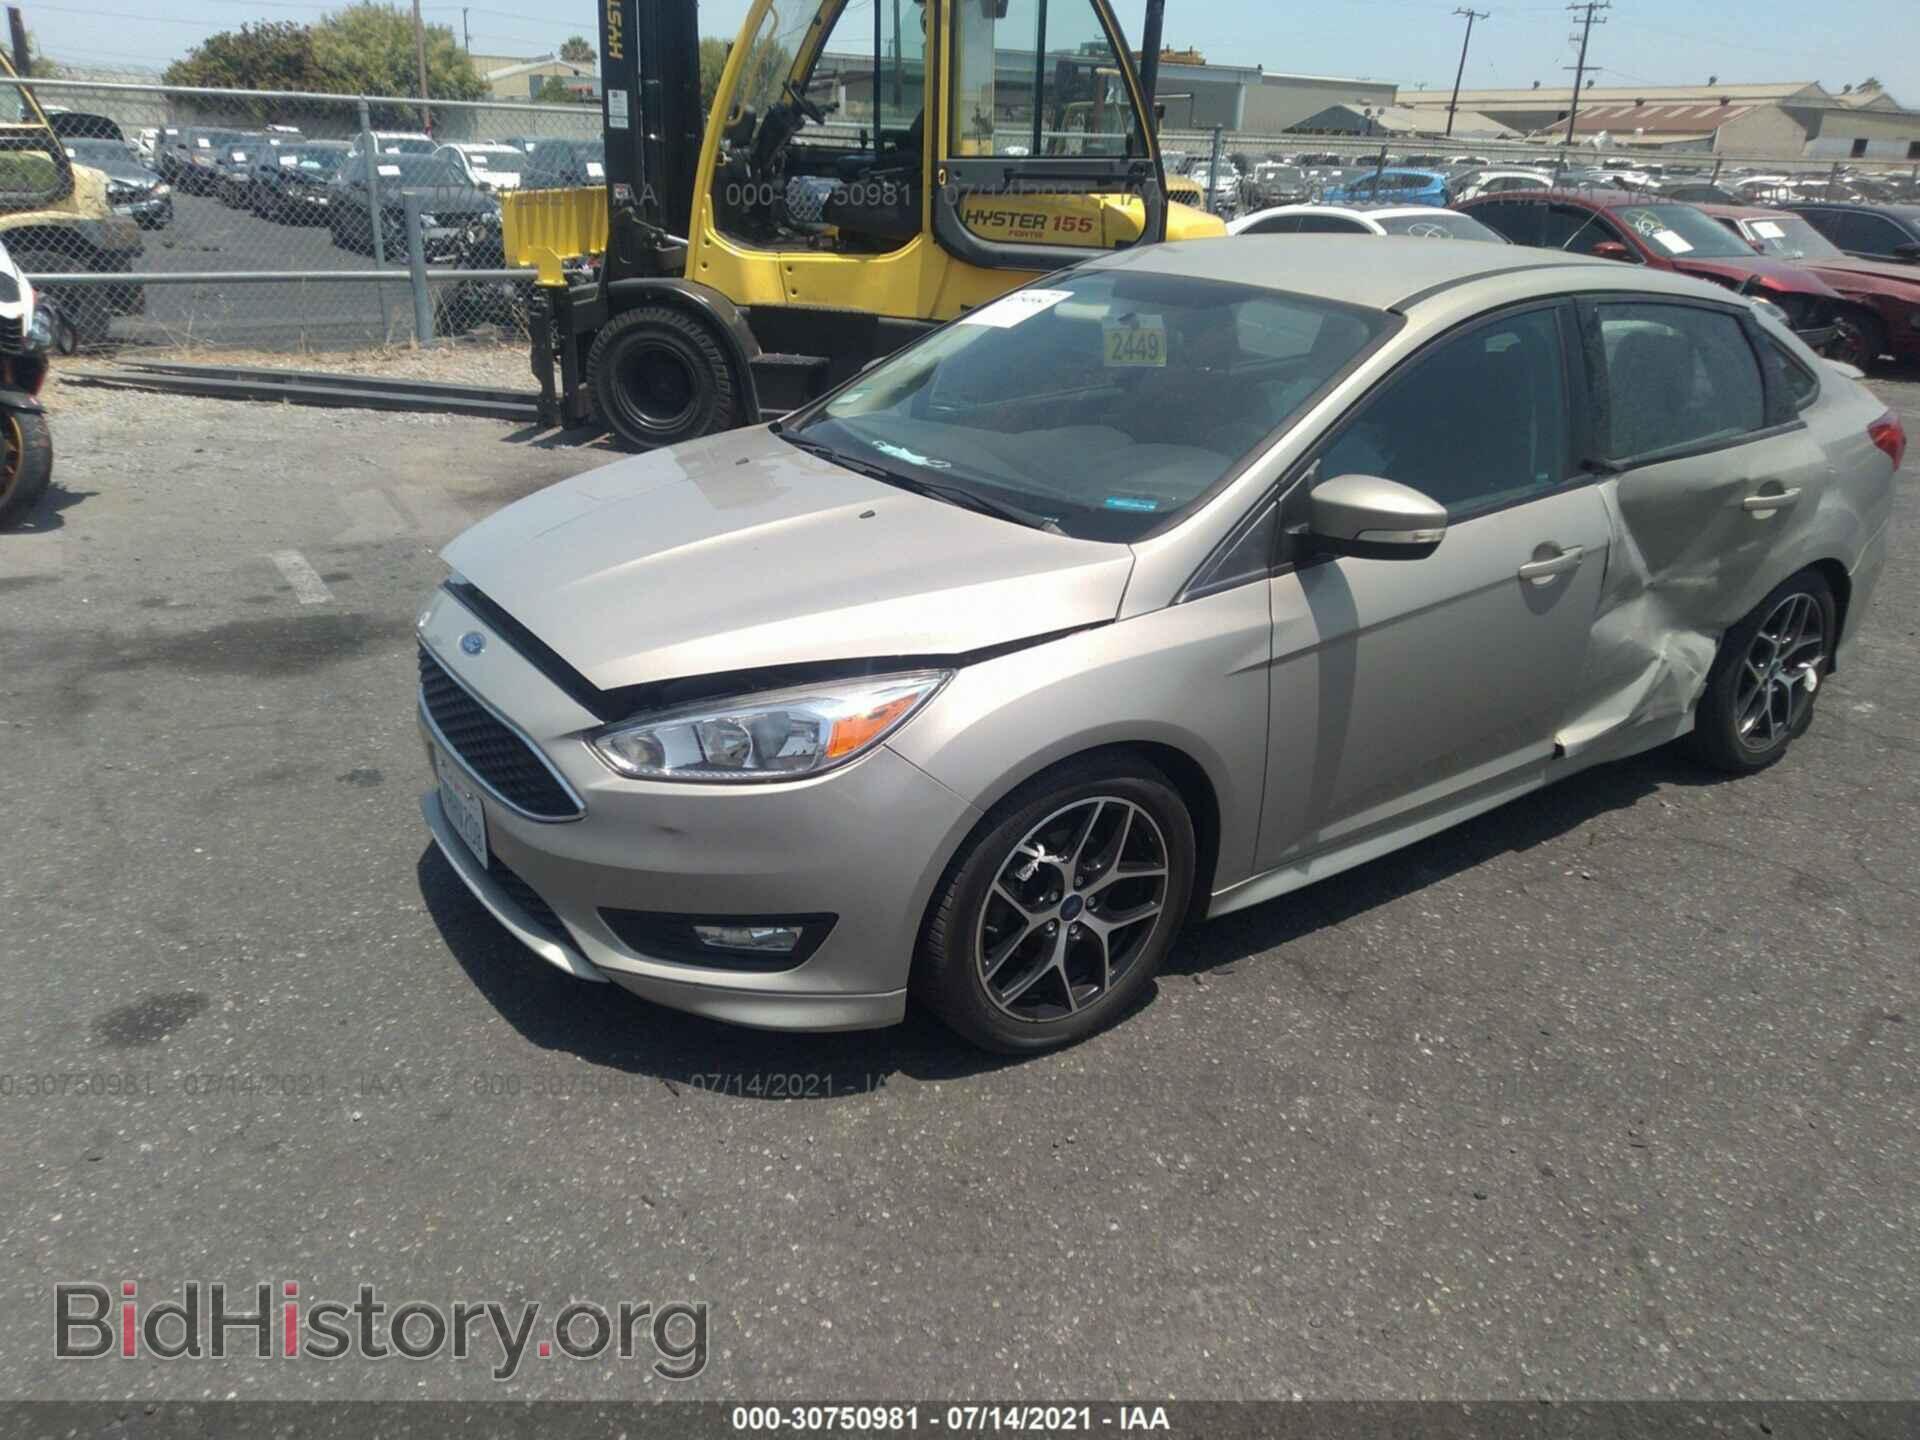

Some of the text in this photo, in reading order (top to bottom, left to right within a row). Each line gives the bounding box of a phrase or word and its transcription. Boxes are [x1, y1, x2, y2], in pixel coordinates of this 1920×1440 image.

[965, 209, 1093, 233] HYSTER 155
[1111, 333, 1159, 361] 2449
